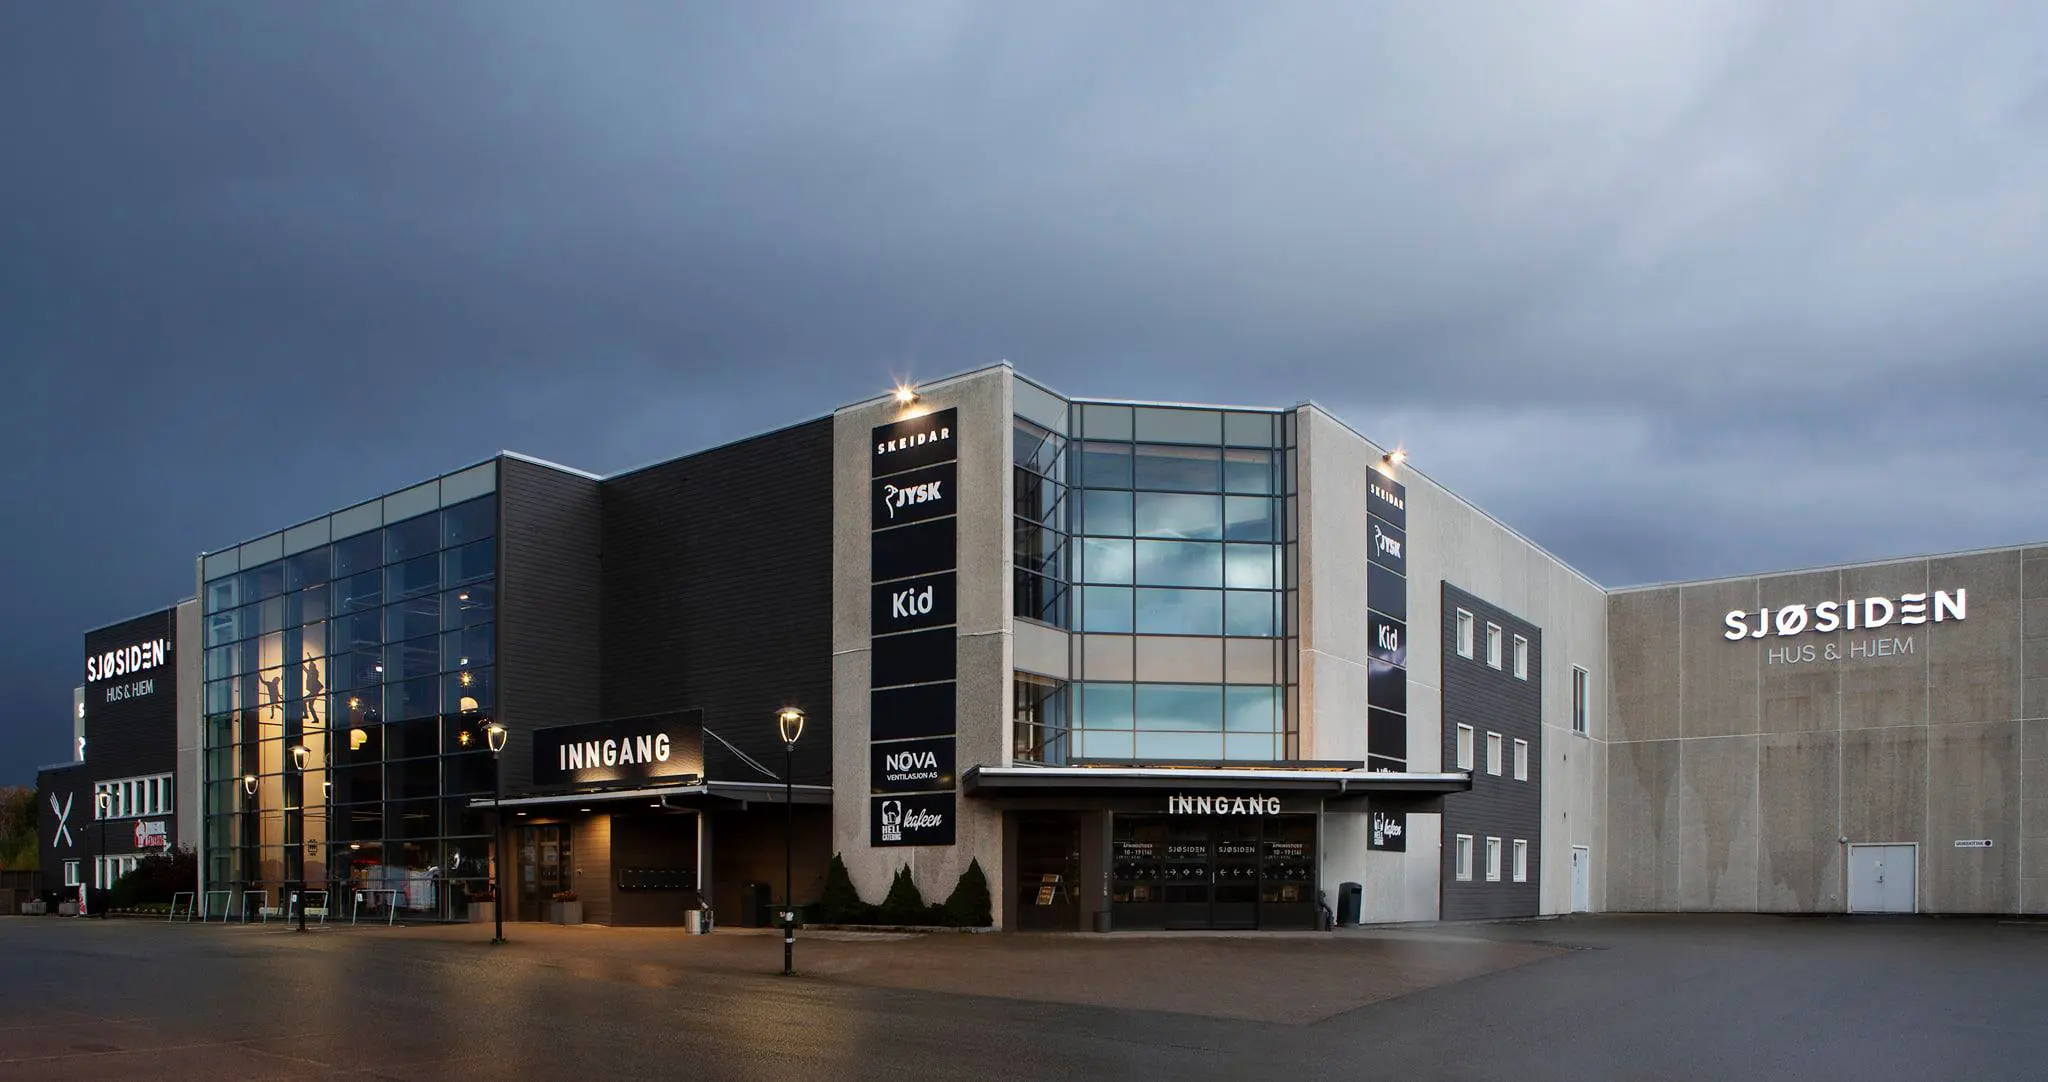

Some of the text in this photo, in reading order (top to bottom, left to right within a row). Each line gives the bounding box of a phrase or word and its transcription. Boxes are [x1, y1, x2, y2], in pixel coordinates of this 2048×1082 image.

[878, 427, 949, 454] SKEIDAR
[897, 481, 943, 507] JYSK
[1370, 484, 1404, 511] SKEIDAR
[1381, 533, 1401, 558] JYSK
[892, 585, 933, 618] Kid
[1724, 589, 1966, 641] SJØSIDEN
[1378, 624, 1398, 653] Kid
[1768, 637, 1914, 665] HUS & HJEM
[87, 639, 164, 688] SJØSIDEN
[107, 679, 154, 703] HUS & HJEM
[560, 733, 670, 770] INNGANG
[886, 751, 938, 772] NOVA
[886, 771, 938, 781] VENTILASJON AS
[1169, 796, 1281, 815] INNGANG
[882, 825, 902, 834] HELL
[903, 808, 943, 831] kafeen
